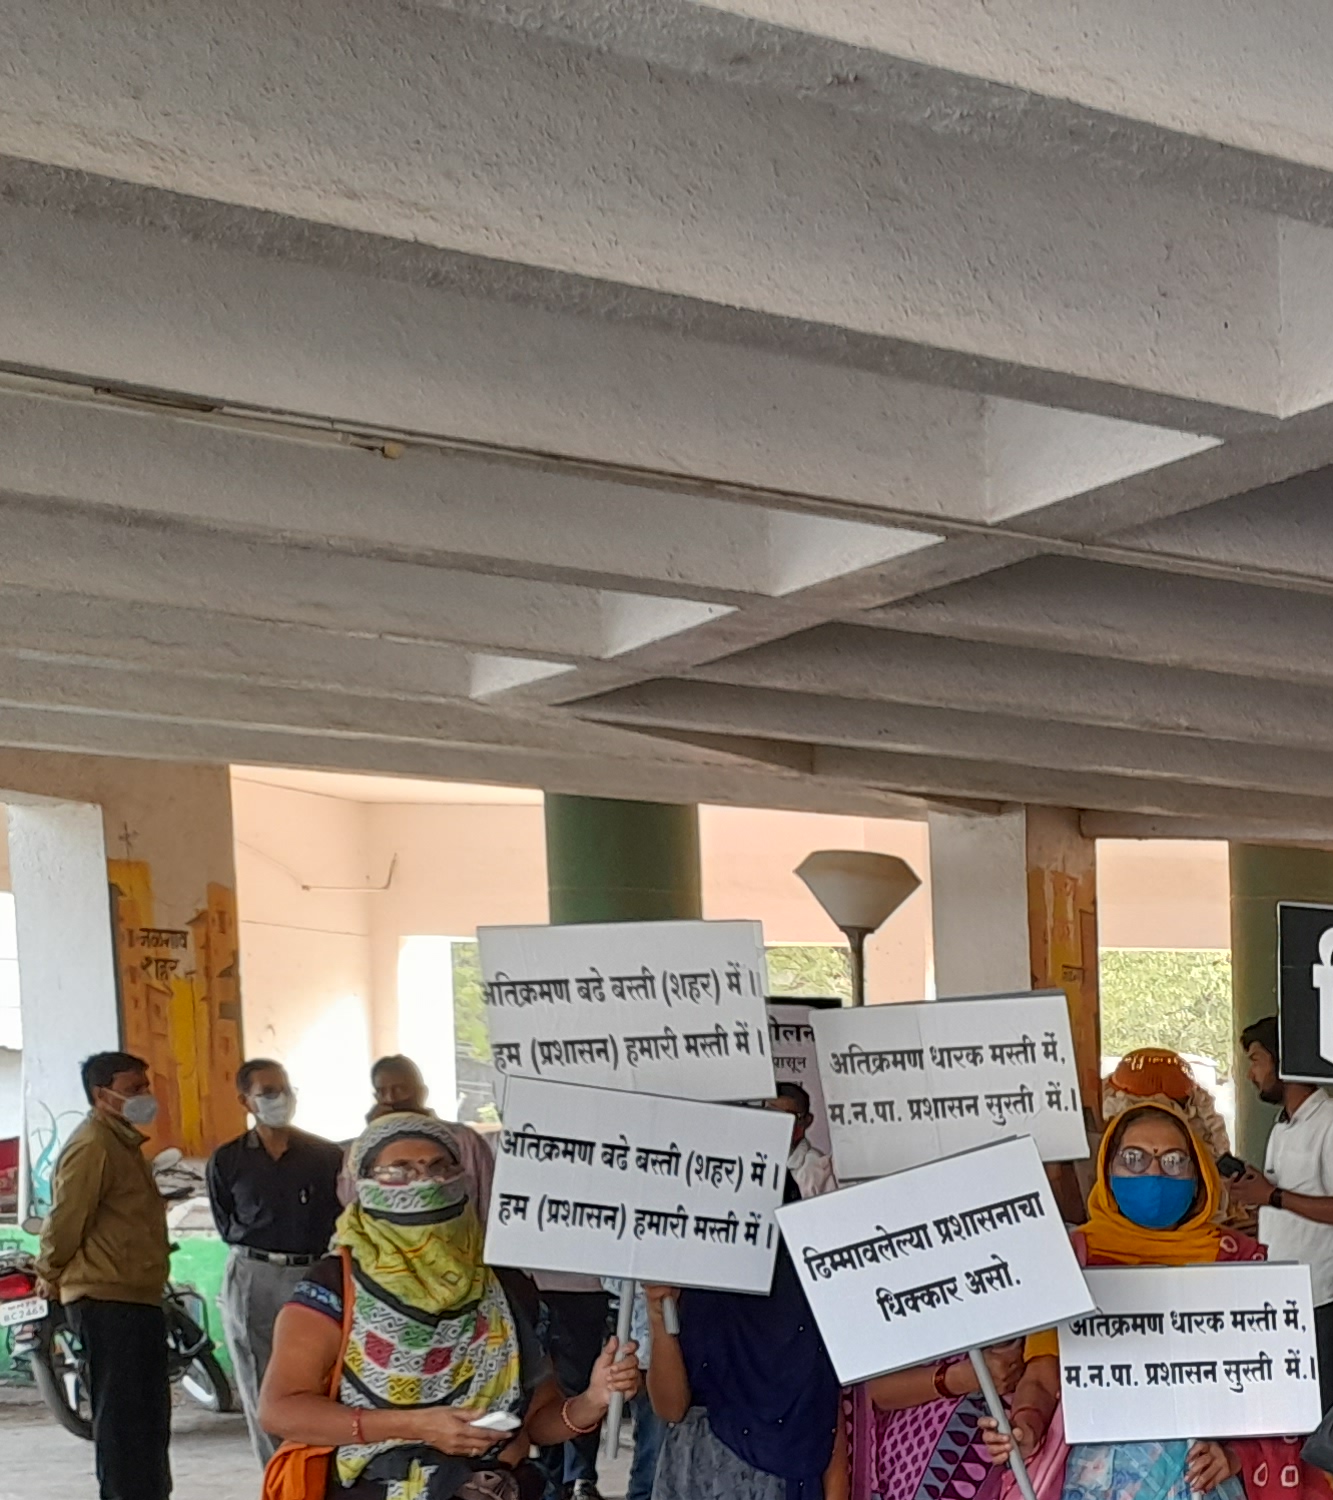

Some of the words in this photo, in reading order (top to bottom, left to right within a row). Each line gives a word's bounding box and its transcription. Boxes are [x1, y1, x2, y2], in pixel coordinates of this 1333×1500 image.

[480, 971, 571, 1008] अतिक्रमण
[608, 965, 657, 1002] बस्ती
[662, 968, 720, 1008] (शहर)
[491, 1042, 522, 1072] हम
[531, 1034, 619, 1075] (प्रशासन)
[623, 1026, 678, 1067] हमारी
[683, 1023, 729, 1058] मस्ती
[828, 1043, 925, 1076] अतिक्रमण
[930, 1045, 984, 1071] धारक
[989, 1034, 1036, 1066] मस्ती
[827, 1099, 902, 1126] म.न.पा.
[906, 1093, 980, 1122] प्रशासन
[500, 1123, 596, 1166] अतिक्रमण
[635, 1142, 681, 1177] बस्ती
[685, 1150, 744, 1193] (शहर)
[498, 1193, 529, 1225] हम
[537, 1194, 626, 1240] (प्रशासन)
[632, 1204, 689, 1240] हमारी
[693, 1210, 739, 1245] मस्ती
[802, 1225, 934, 1282] ढिम्मावलेल्या
[932, 1191, 1046, 1245] प्रशासनाचा
[875, 1276, 964, 1322] धिक्कार
[964, 1253, 1022, 1295] असो.
[1169, 1310, 1225, 1334] धारक
[1230, 1301, 1278, 1332] मस्ती
[1064, 1363, 1139, 1389] म.न.पा.
[1144, 1360, 1218, 1387] प्रशासन
[1222, 1351, 1274, 1393] सुस्ती
